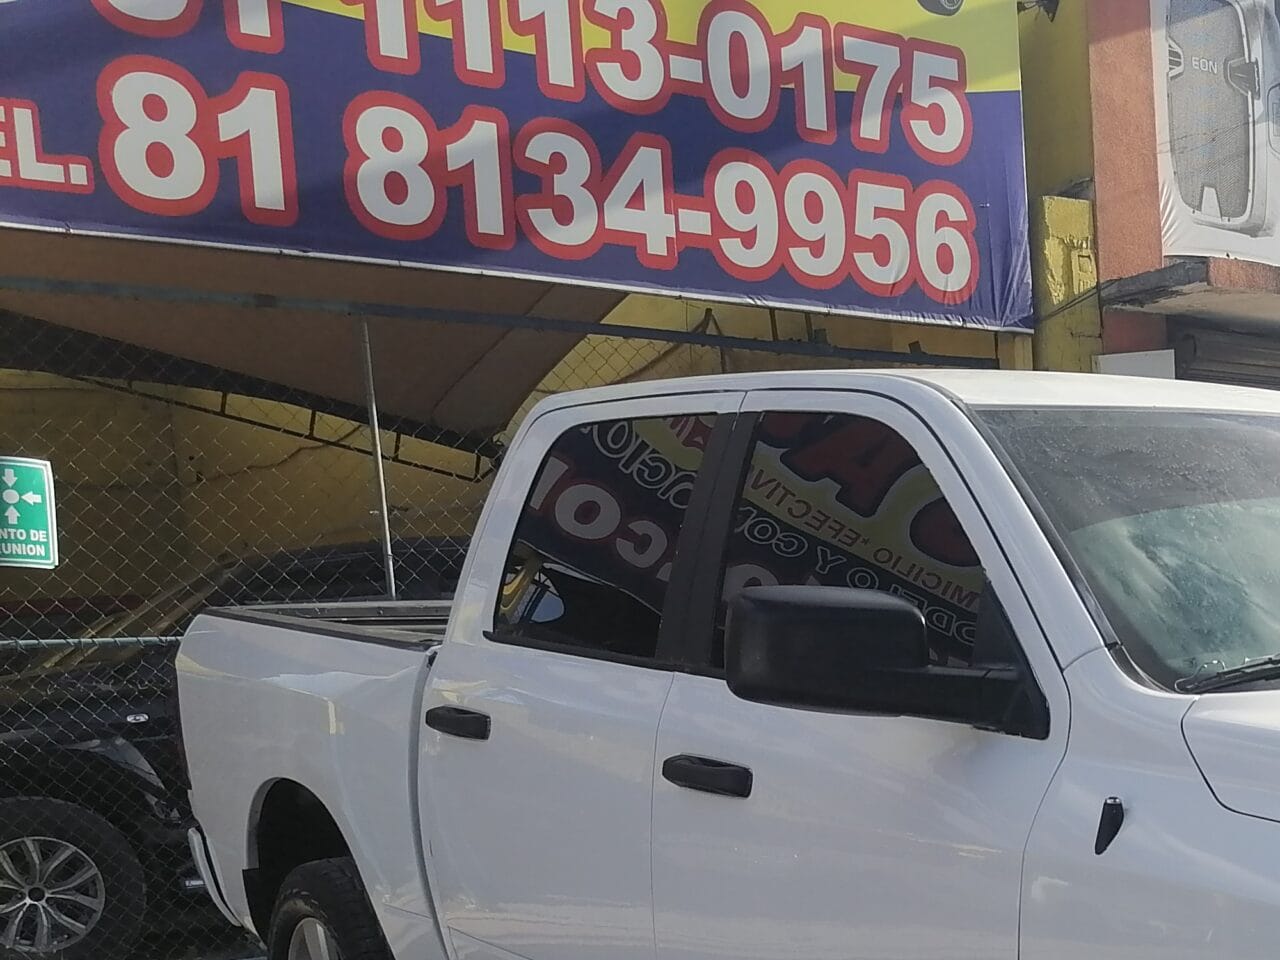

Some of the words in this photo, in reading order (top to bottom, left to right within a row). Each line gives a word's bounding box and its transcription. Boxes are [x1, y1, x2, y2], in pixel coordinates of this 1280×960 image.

[0, 104, 91, 186] L.
[110, 70, 288, 212] 81
[354, 105, 974, 293] 8134-9956
[30, 529, 48, 542] DE
